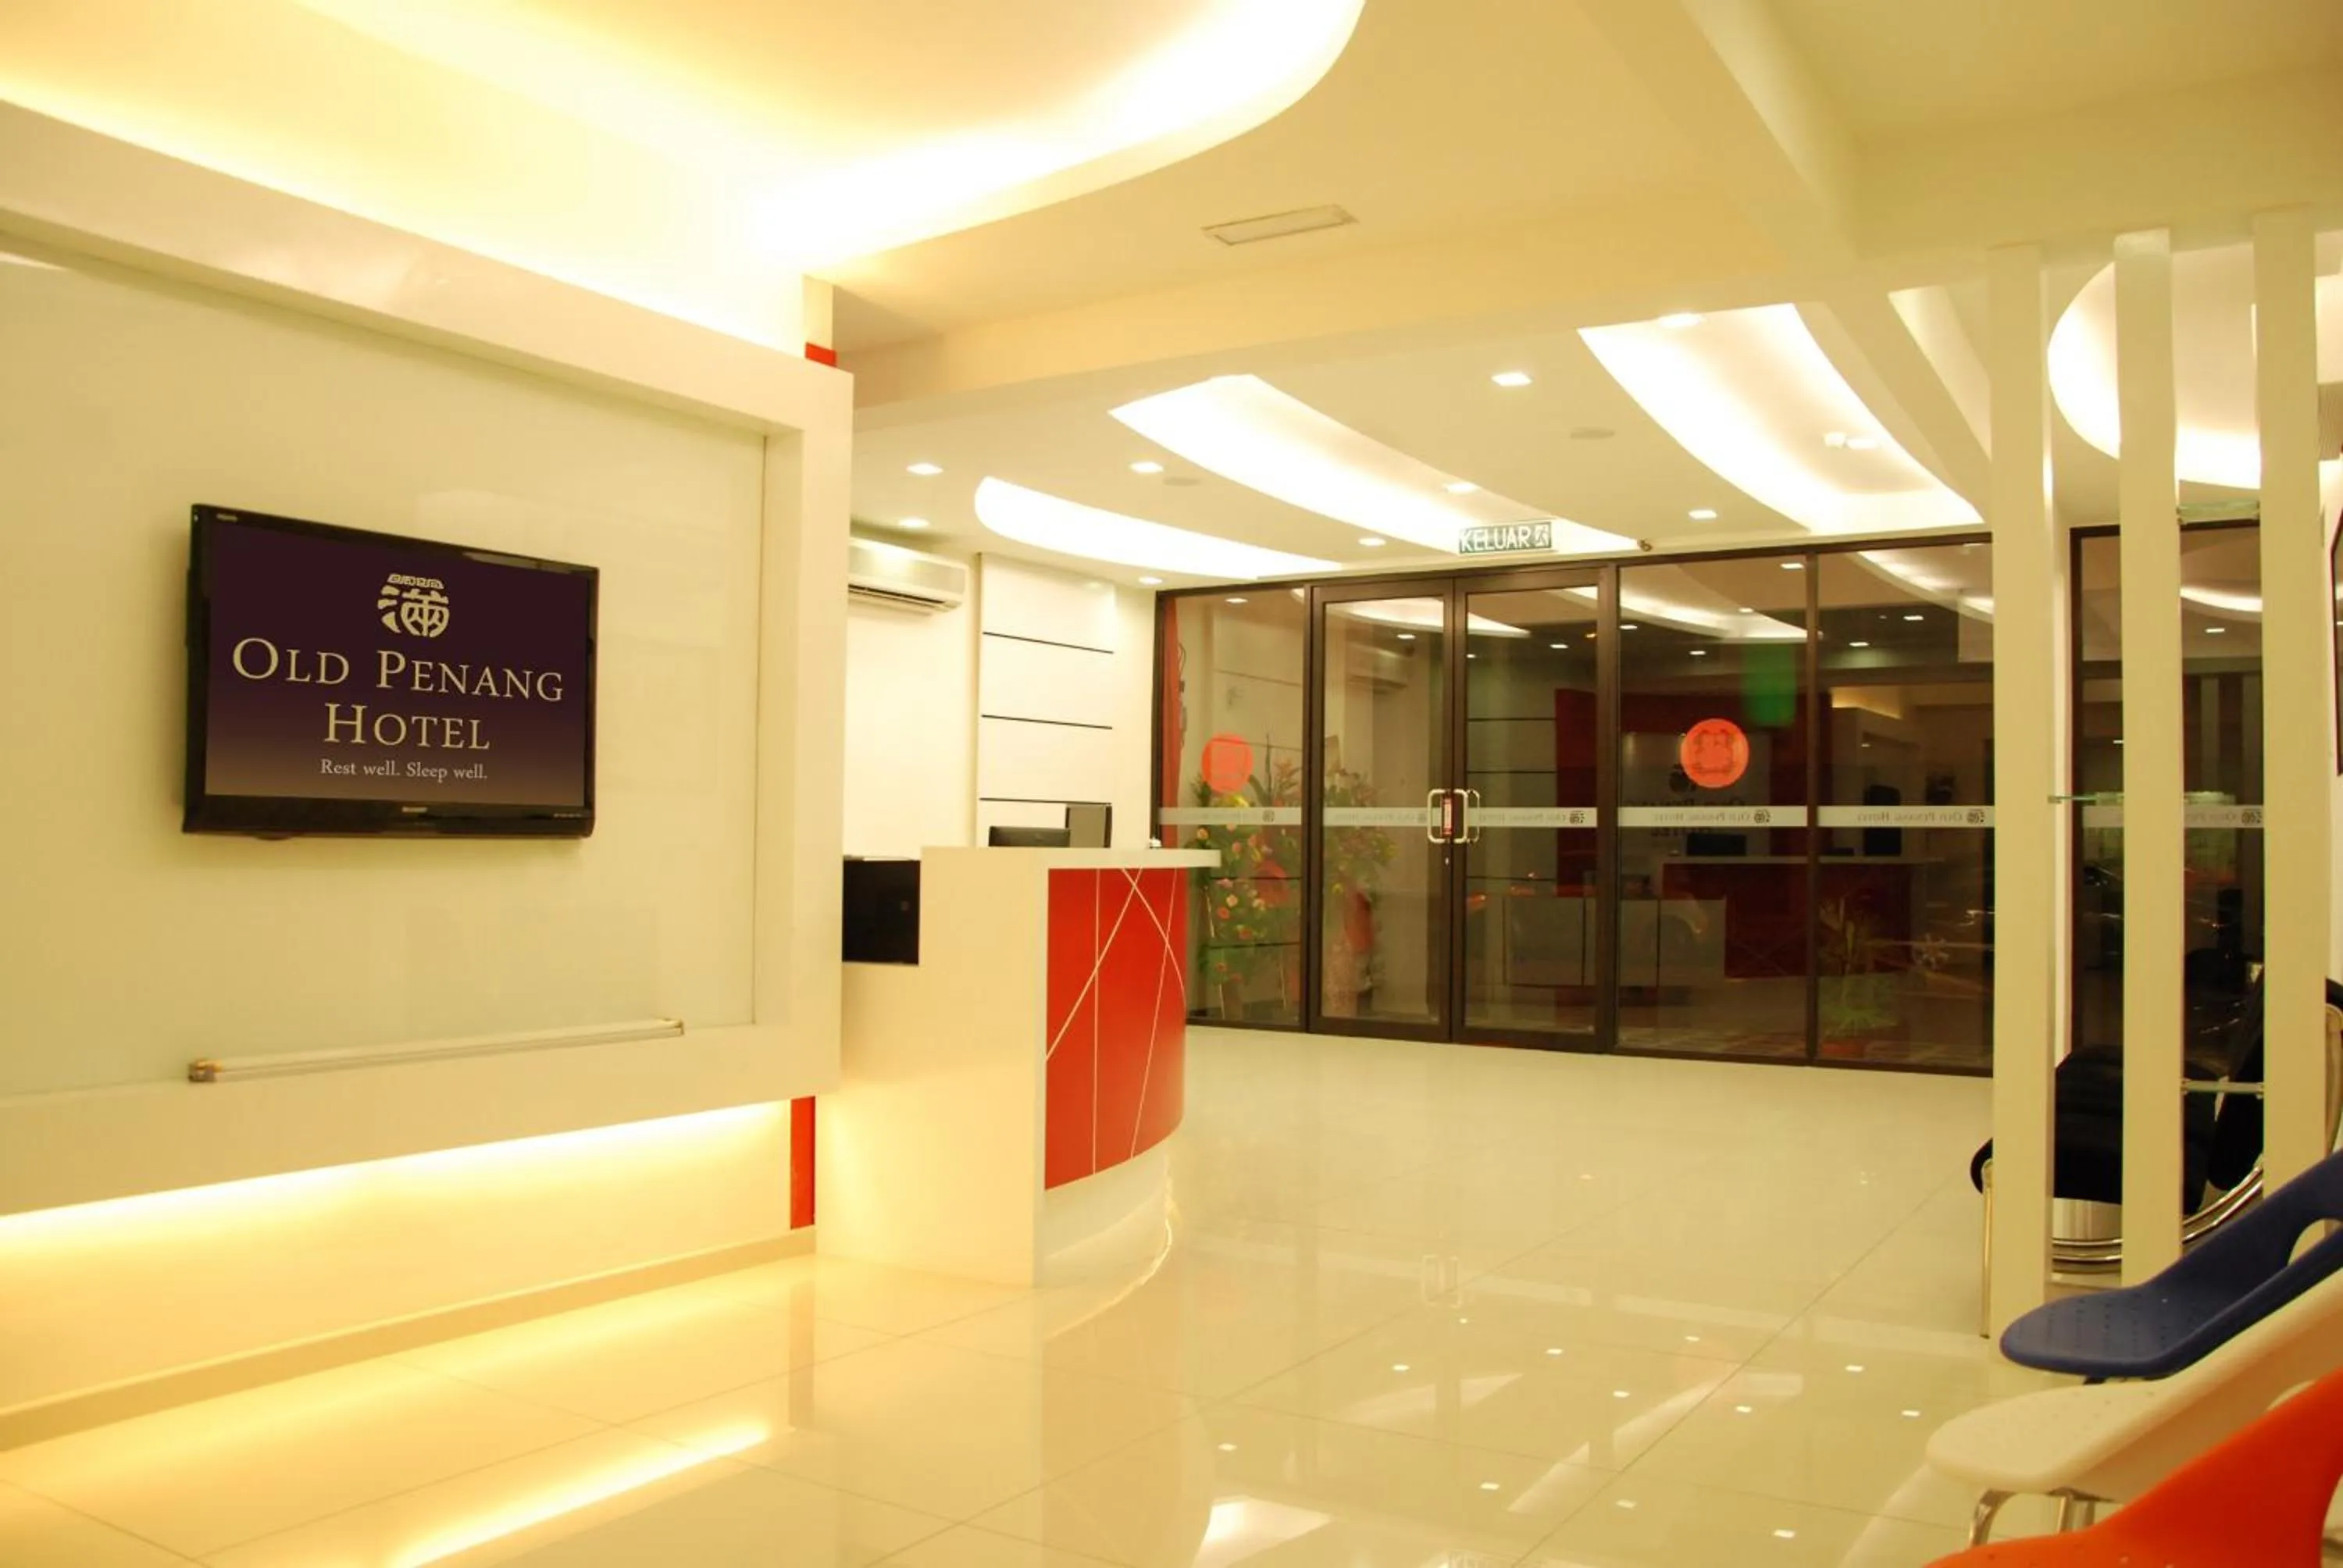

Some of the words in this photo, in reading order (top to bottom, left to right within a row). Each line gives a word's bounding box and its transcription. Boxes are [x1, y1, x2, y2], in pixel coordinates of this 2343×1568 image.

[1460, 526, 1532, 551] KELUAR
[233, 637, 349, 685] OLD
[376, 650, 563, 701] PENANG
[323, 703, 490, 750] HOTEL
[320, 758, 356, 775] Rest
[362, 761, 401, 776] well.
[406, 761, 448, 783] Sleep
[452, 764, 489, 780] well.
